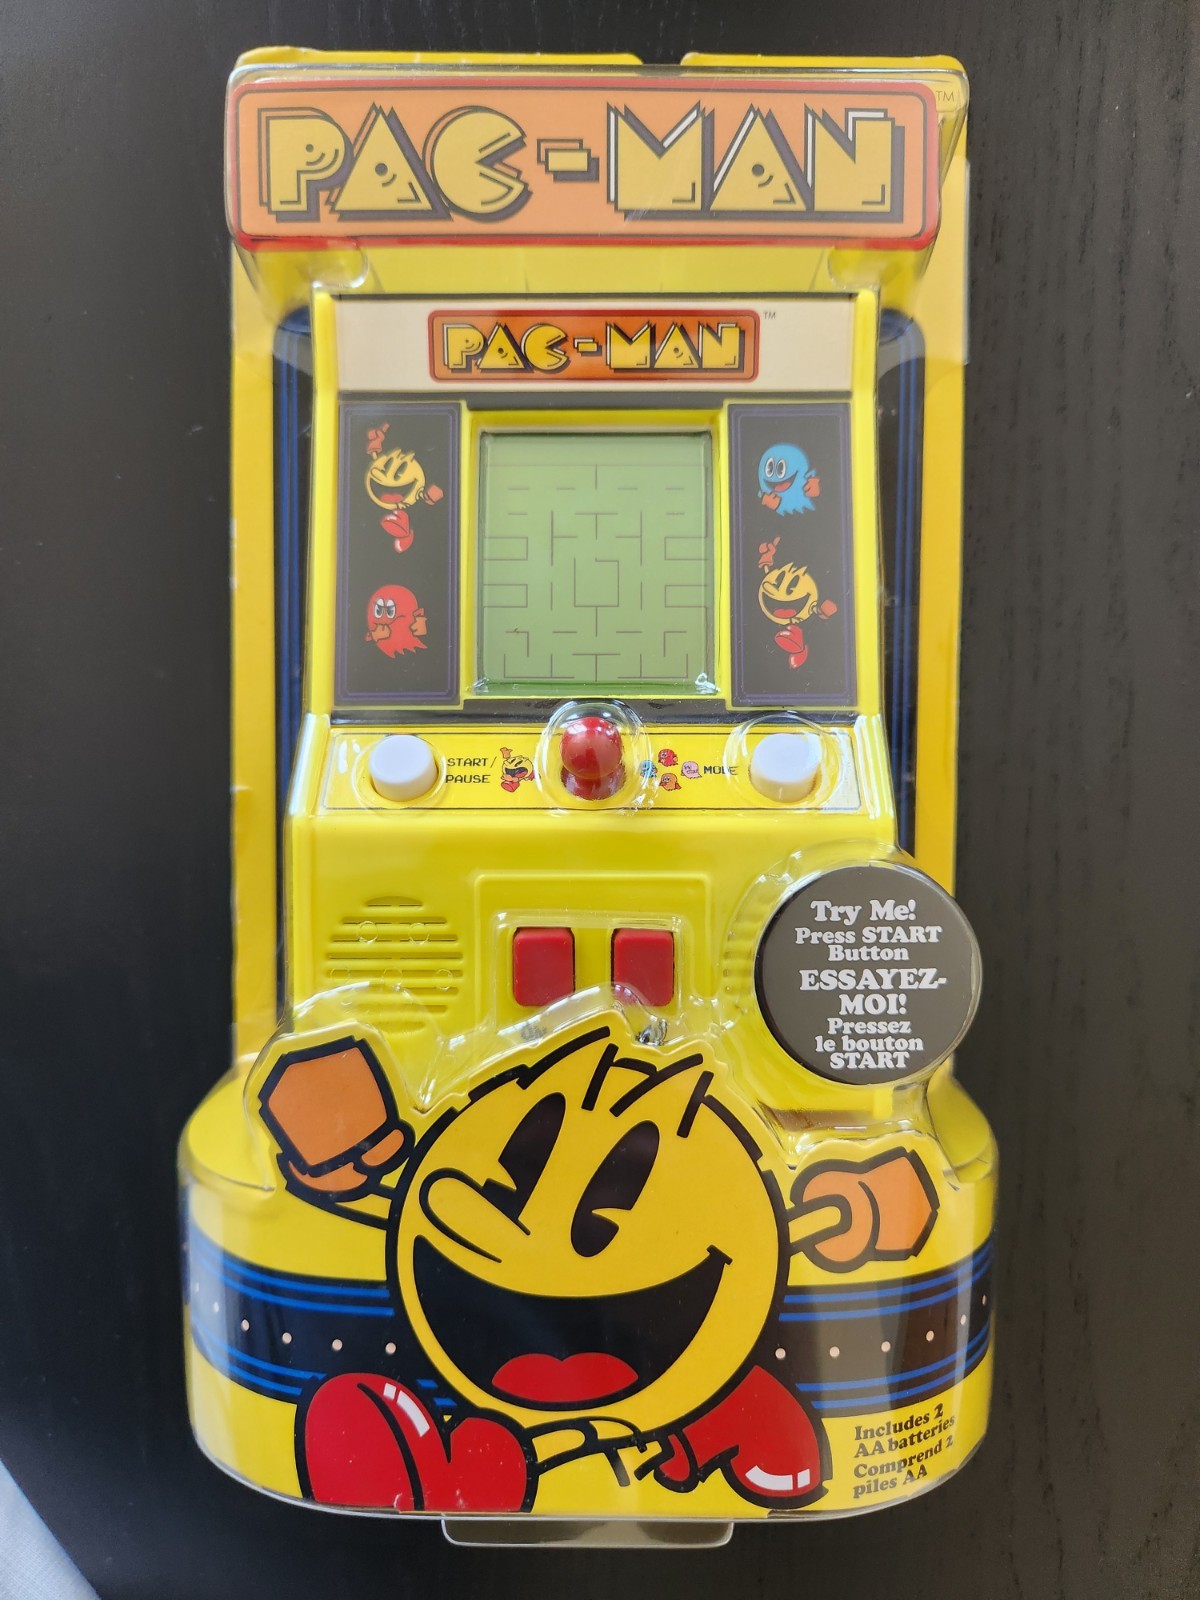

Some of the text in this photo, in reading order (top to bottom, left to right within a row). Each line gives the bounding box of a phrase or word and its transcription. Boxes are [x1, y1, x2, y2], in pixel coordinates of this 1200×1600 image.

[257, 90, 955, 223] PAC-MAN TM
[442, 311, 776, 374] PAC-MAN TM
[445, 774, 491, 783] PAUSE
[810, 899, 917, 926] Try Me!
[795, 925, 943, 944] Press START
[828, 944, 909, 961] Button
[799, 967, 948, 991] ESSAYEZ-
[838, 993, 908, 1015] MOI!
[827, 1018, 911, 1034] Pressez
[815, 1036, 924, 1052] le bouton
[829, 1052, 910, 1069] START
[854, 1402, 944, 1440] Includes 2
[854, 1415, 955, 1458] AA batteries
[853, 1434, 954, 1478] Comprend 2
[853, 1464, 928, 1499] piles AA
